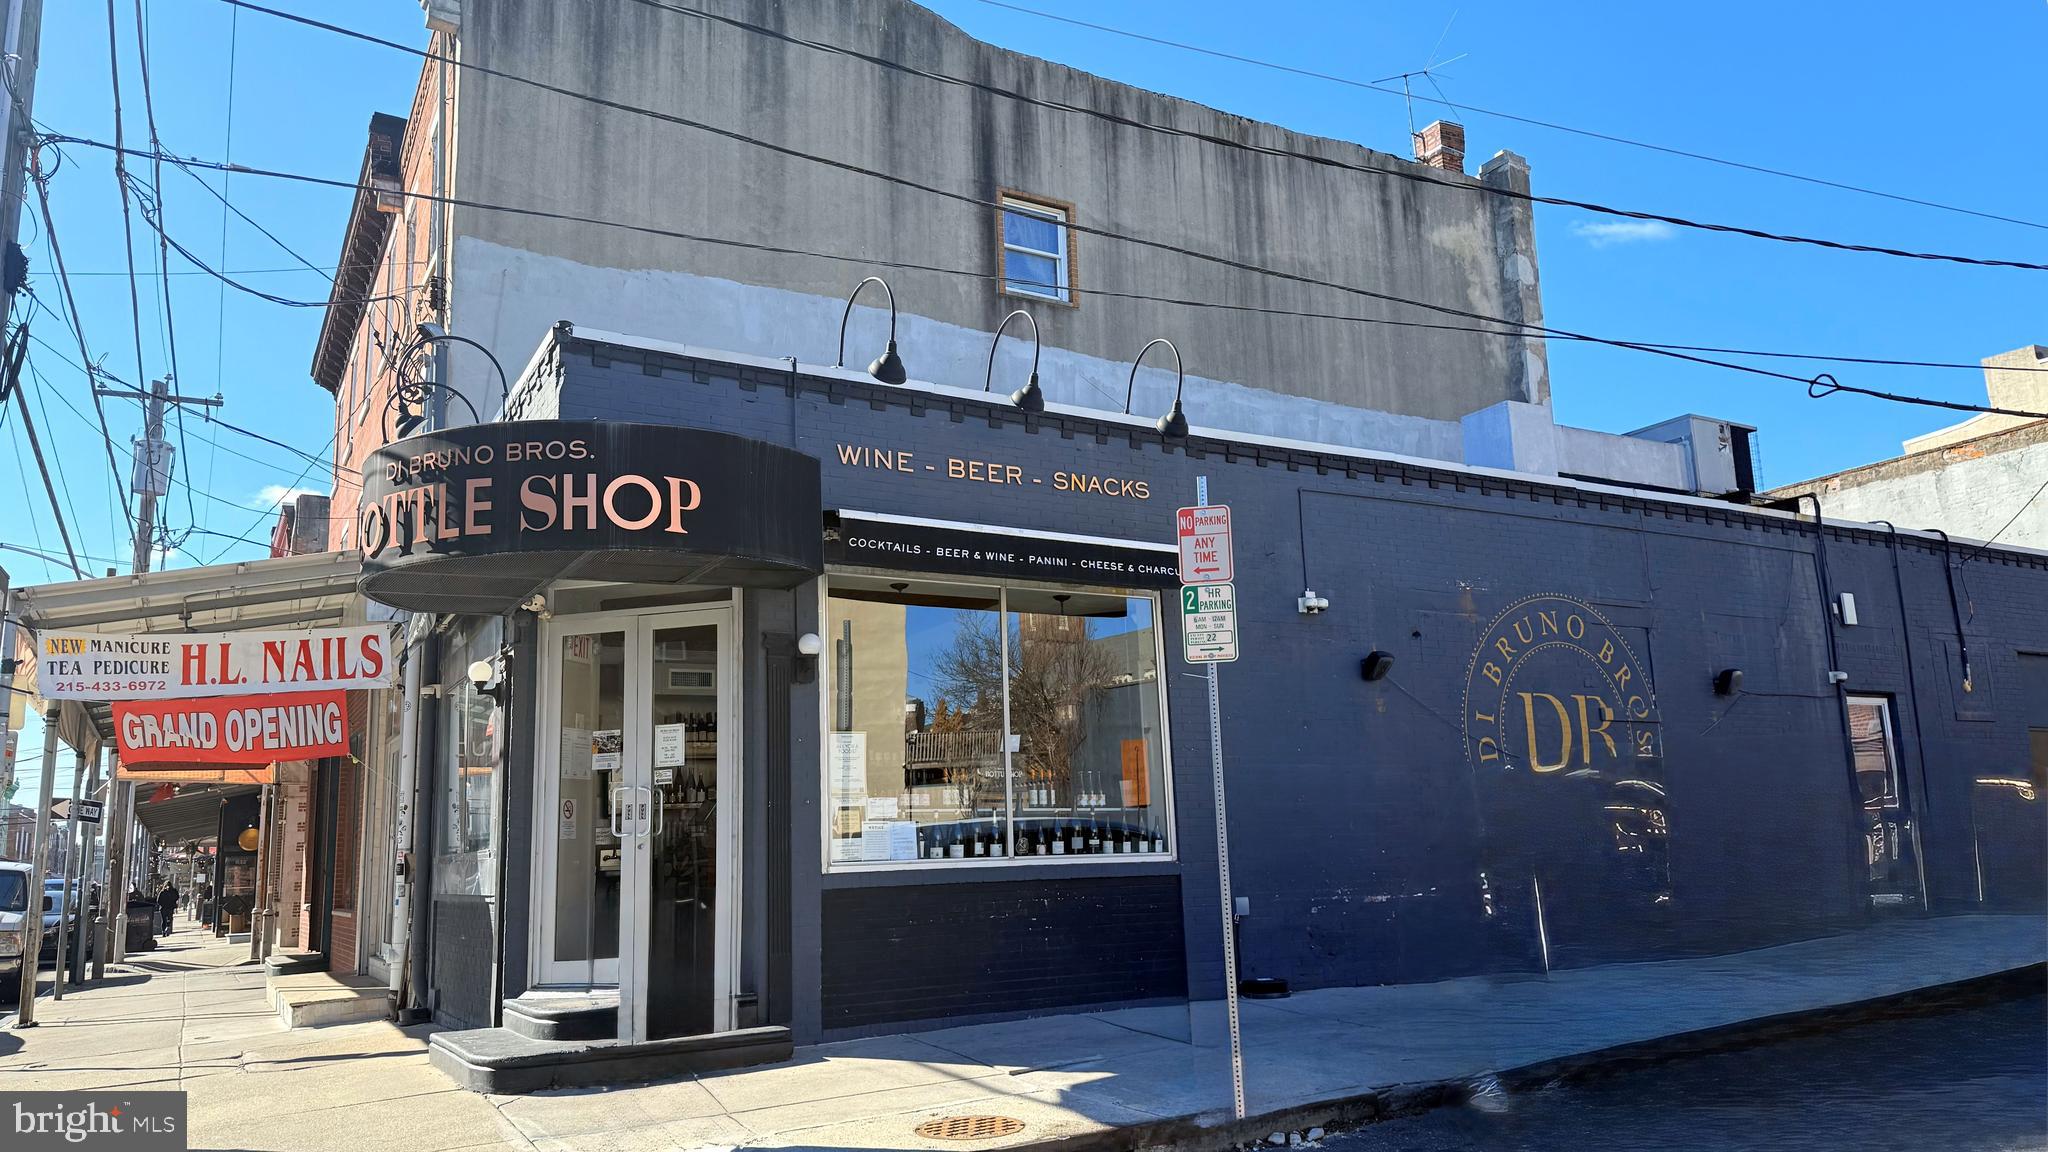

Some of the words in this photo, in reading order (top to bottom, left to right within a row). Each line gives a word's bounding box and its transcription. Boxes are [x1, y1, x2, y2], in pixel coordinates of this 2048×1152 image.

[386, 462, 402, 481] DI
[409, 445, 494, 475] BRUNO
[506, 440, 596, 463] BROS.
[837, 444, 914, 473] WINE
[948, 458, 1022, 485] BEER
[1053, 472, 1150, 500] SNACKS
[362, 477, 493, 557] OTTLE
[520, 473, 702, 535] SHOP
[1180, 516, 1193, 530] NO
[1195, 515, 1227, 527] PARKING
[1194, 537, 1215, 549] ANY
[848, 537, 921, 555] COCKTAILS
[936, 547, 969, 559] BEER
[974, 551, 981, 560] &
[985, 551, 1015, 563] WINE
[1029, 555, 1068, 567] PANINI
[1080, 559, 1124, 572] CHEESE
[1128, 563, 1135, 572] &
[1194, 551, 1218, 563] TIME
[1186, 590, 1196, 610] 2
[1208, 588, 1221, 599] HR
[1200, 600, 1232, 611] PARKING
[50, 638, 83, 654] NEW
[90, 639, 171, 655] MANICURE
[574, 636, 590, 659] EXIT
[1206, 633, 1217, 642] 22
[1481, 610, 1584, 687] BRUNO
[47, 660, 83, 676] TEA
[94, 659, 170, 675] PEDICURE
[180, 643, 248, 686] H.L.
[263, 634, 383, 684] NAILS
[56, 680, 167, 692] 215-433-6972
[122, 711, 218, 751] GRAND
[225, 701, 343, 752] OPENING
[1475, 710, 1498, 763] DI
[85, 806, 98, 816] WAY
